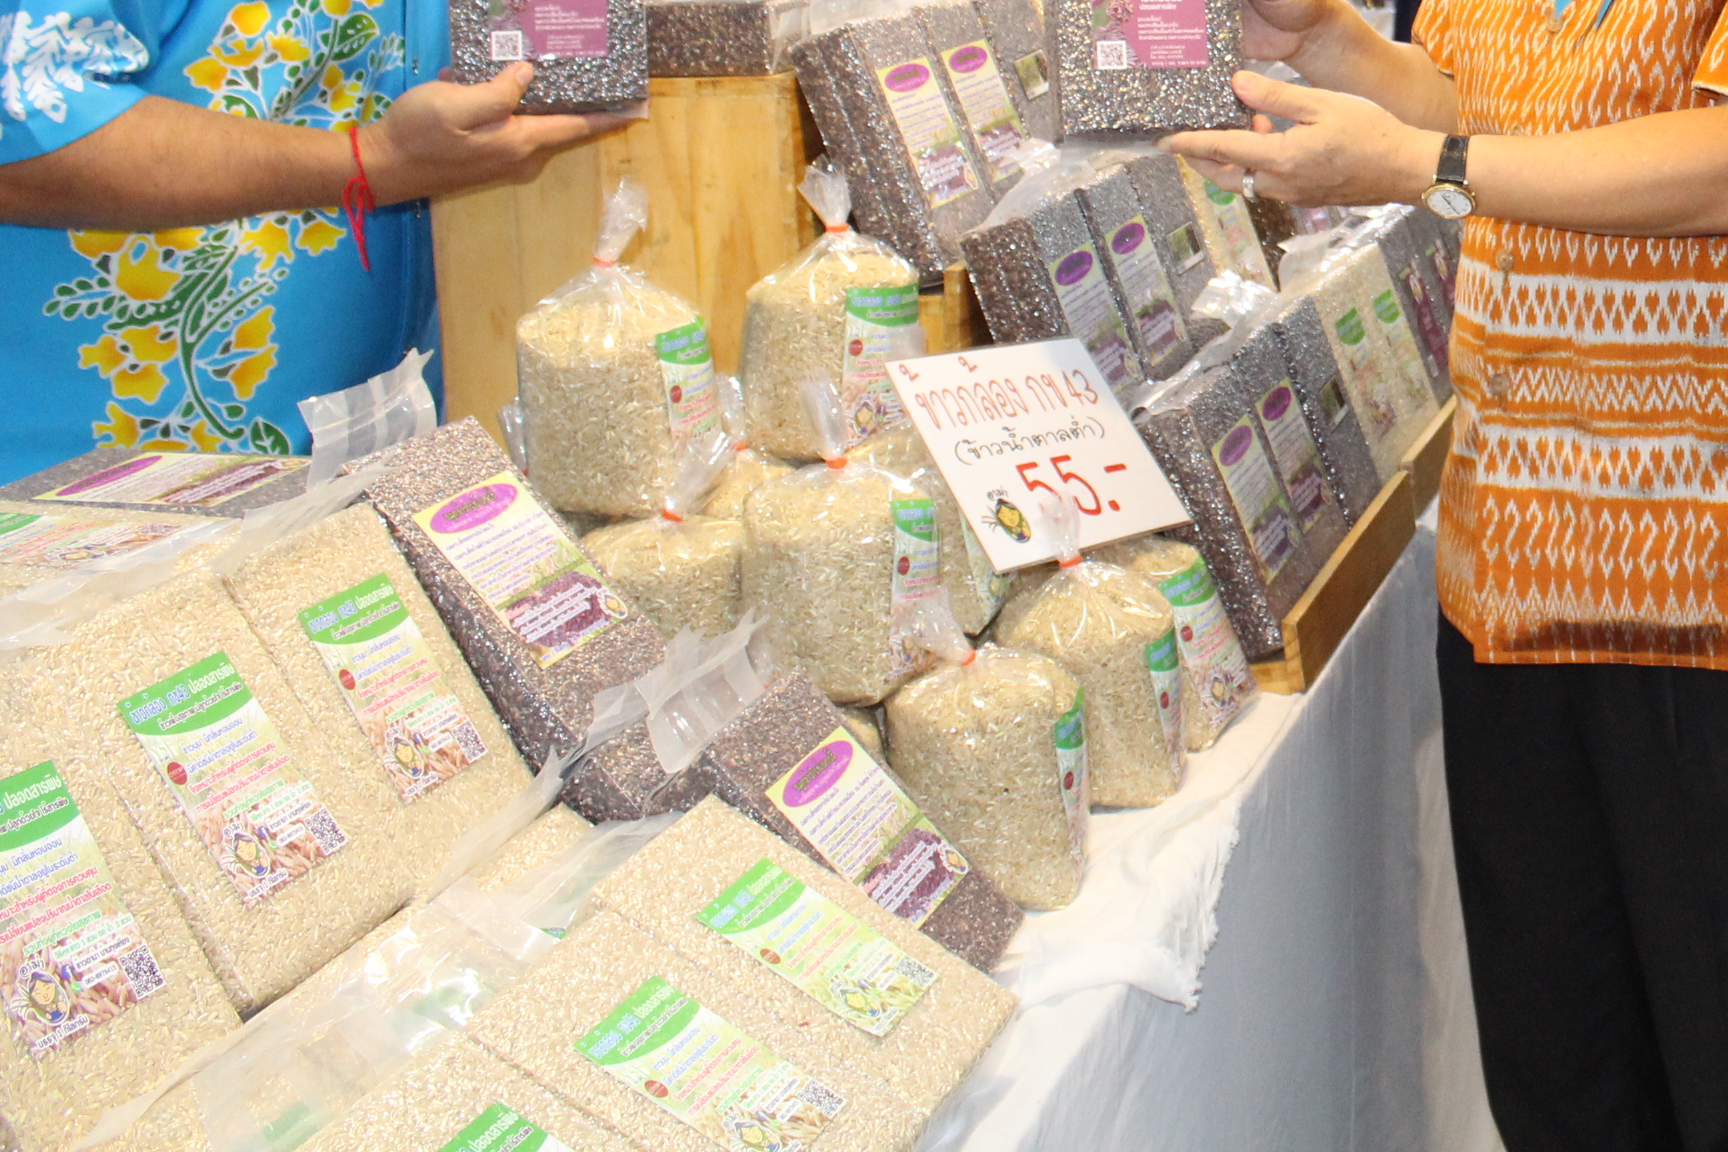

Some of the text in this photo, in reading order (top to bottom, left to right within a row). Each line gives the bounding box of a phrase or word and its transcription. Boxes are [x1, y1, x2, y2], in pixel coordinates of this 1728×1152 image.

[899, 356, 1028, 430] ข้าวกล้อง
[955, 415, 1105, 466] (ข้าวน้ำตาลต่ำ)
[1016, 455, 1126, 515] 55.-
[184, 657, 234, 694] ปลอดสารพิษ
[2, 772, 61, 809] ปลอดสารพิษ
[18, 954, 45, 977] อาม่า
